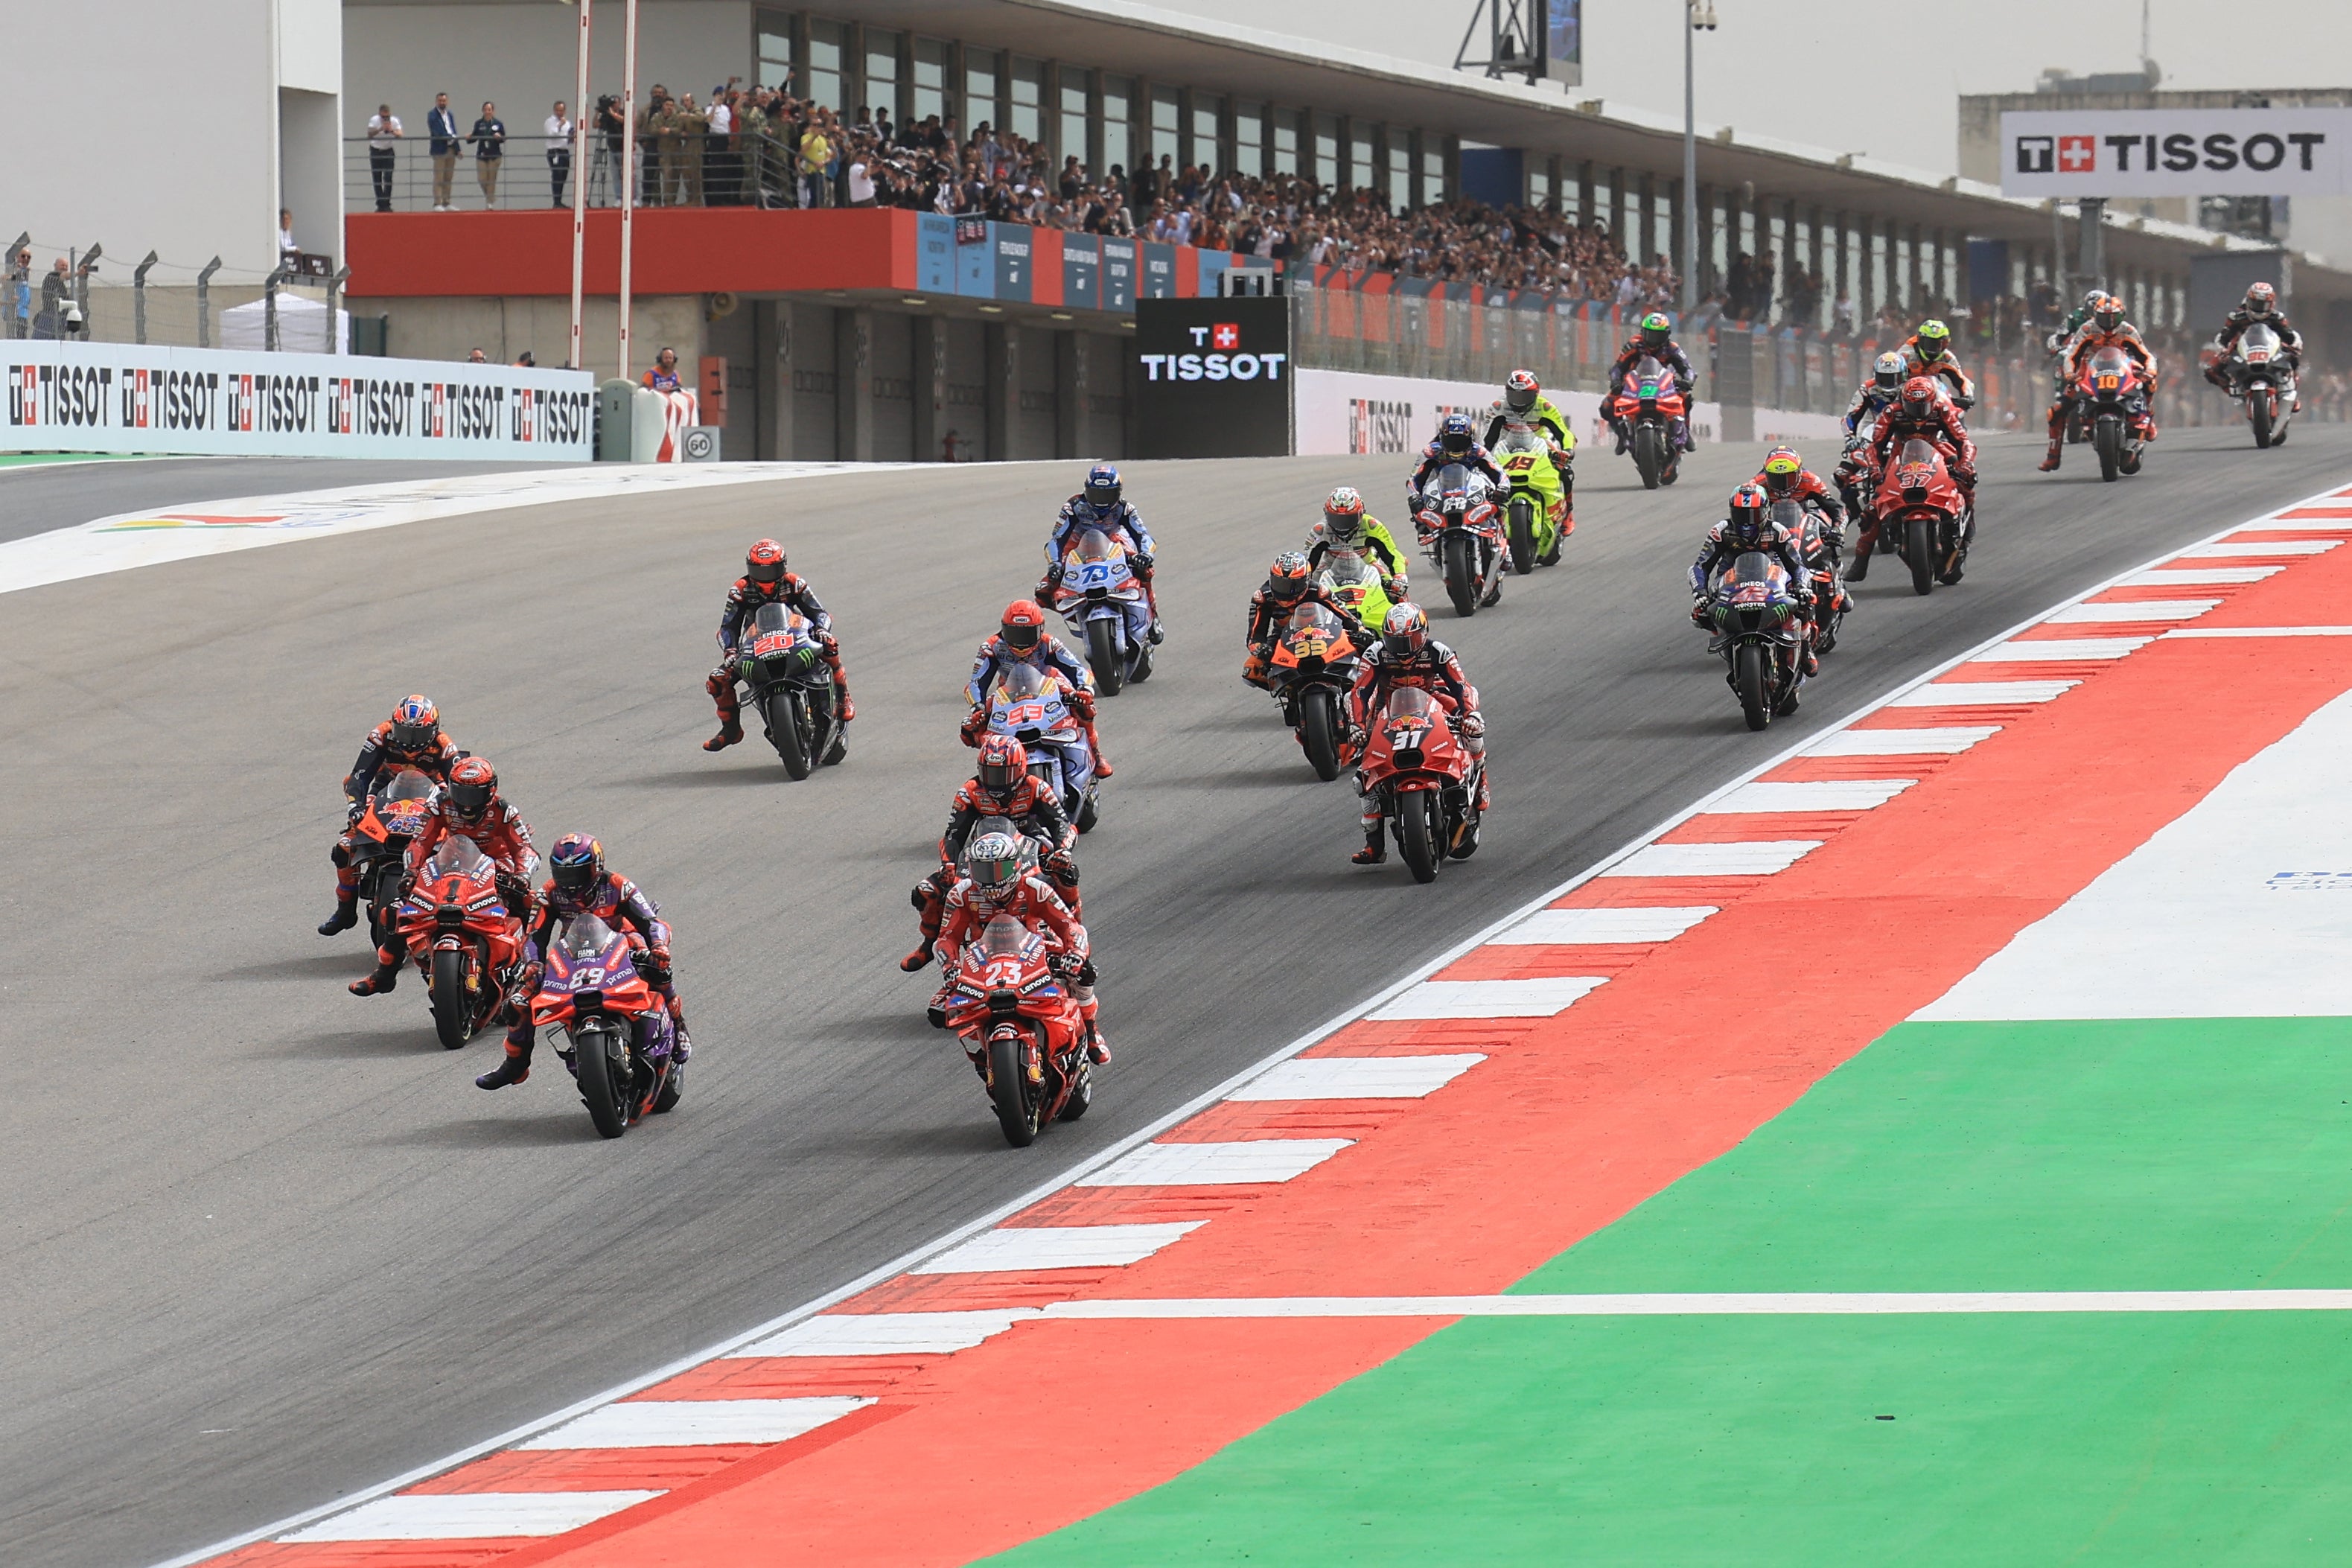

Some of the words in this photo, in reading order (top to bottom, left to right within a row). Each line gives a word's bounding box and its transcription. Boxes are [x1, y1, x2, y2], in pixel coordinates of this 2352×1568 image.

[2105, 133, 2324, 171] TISSOT
[1140, 353, 1286, 380] TISSOT
[2097, 375, 2119, 389] 10
[39, 365, 112, 427] TISSOT
[150, 370, 218, 430] TISSOT
[255, 375, 319, 433] TISSOT
[354, 380, 413, 436] TISSOT
[447, 384, 503, 439] TISSOT
[535, 389, 589, 444] TISSOT
[689, 439, 707, 451] 60
[1503, 456, 1537, 471] 49
[1900, 472, 1932, 489] 37
[762, 630, 788, 639] ENEOS
[753, 633, 794, 657] 20
[759, 649, 791, 660] MONSTER
[1295, 639, 1328, 659] 33
[1333, 648, 1345, 657] KTM
[1392, 730, 1422, 751] 31
[987, 753, 1004, 762] Arai
[444, 879, 460, 902] 1
[409, 894, 433, 911] Lenovo
[466, 896, 497, 912] Lenovo
[576, 957, 596, 966] prima
[577, 949, 596, 959] FIAMM
[609, 944, 628, 967] PRAMAC
[550, 954, 565, 975] PRAMAC
[985, 961, 1022, 987] 23
[543, 980, 567, 990] prima
[569, 967, 605, 990] 89
[605, 967, 633, 986] prima
[614, 980, 638, 992] MOTUL
[1019, 975, 1051, 995] Lenovo
[541, 993, 562, 1001] MOTUL
[956, 982, 984, 998] Lenovo
